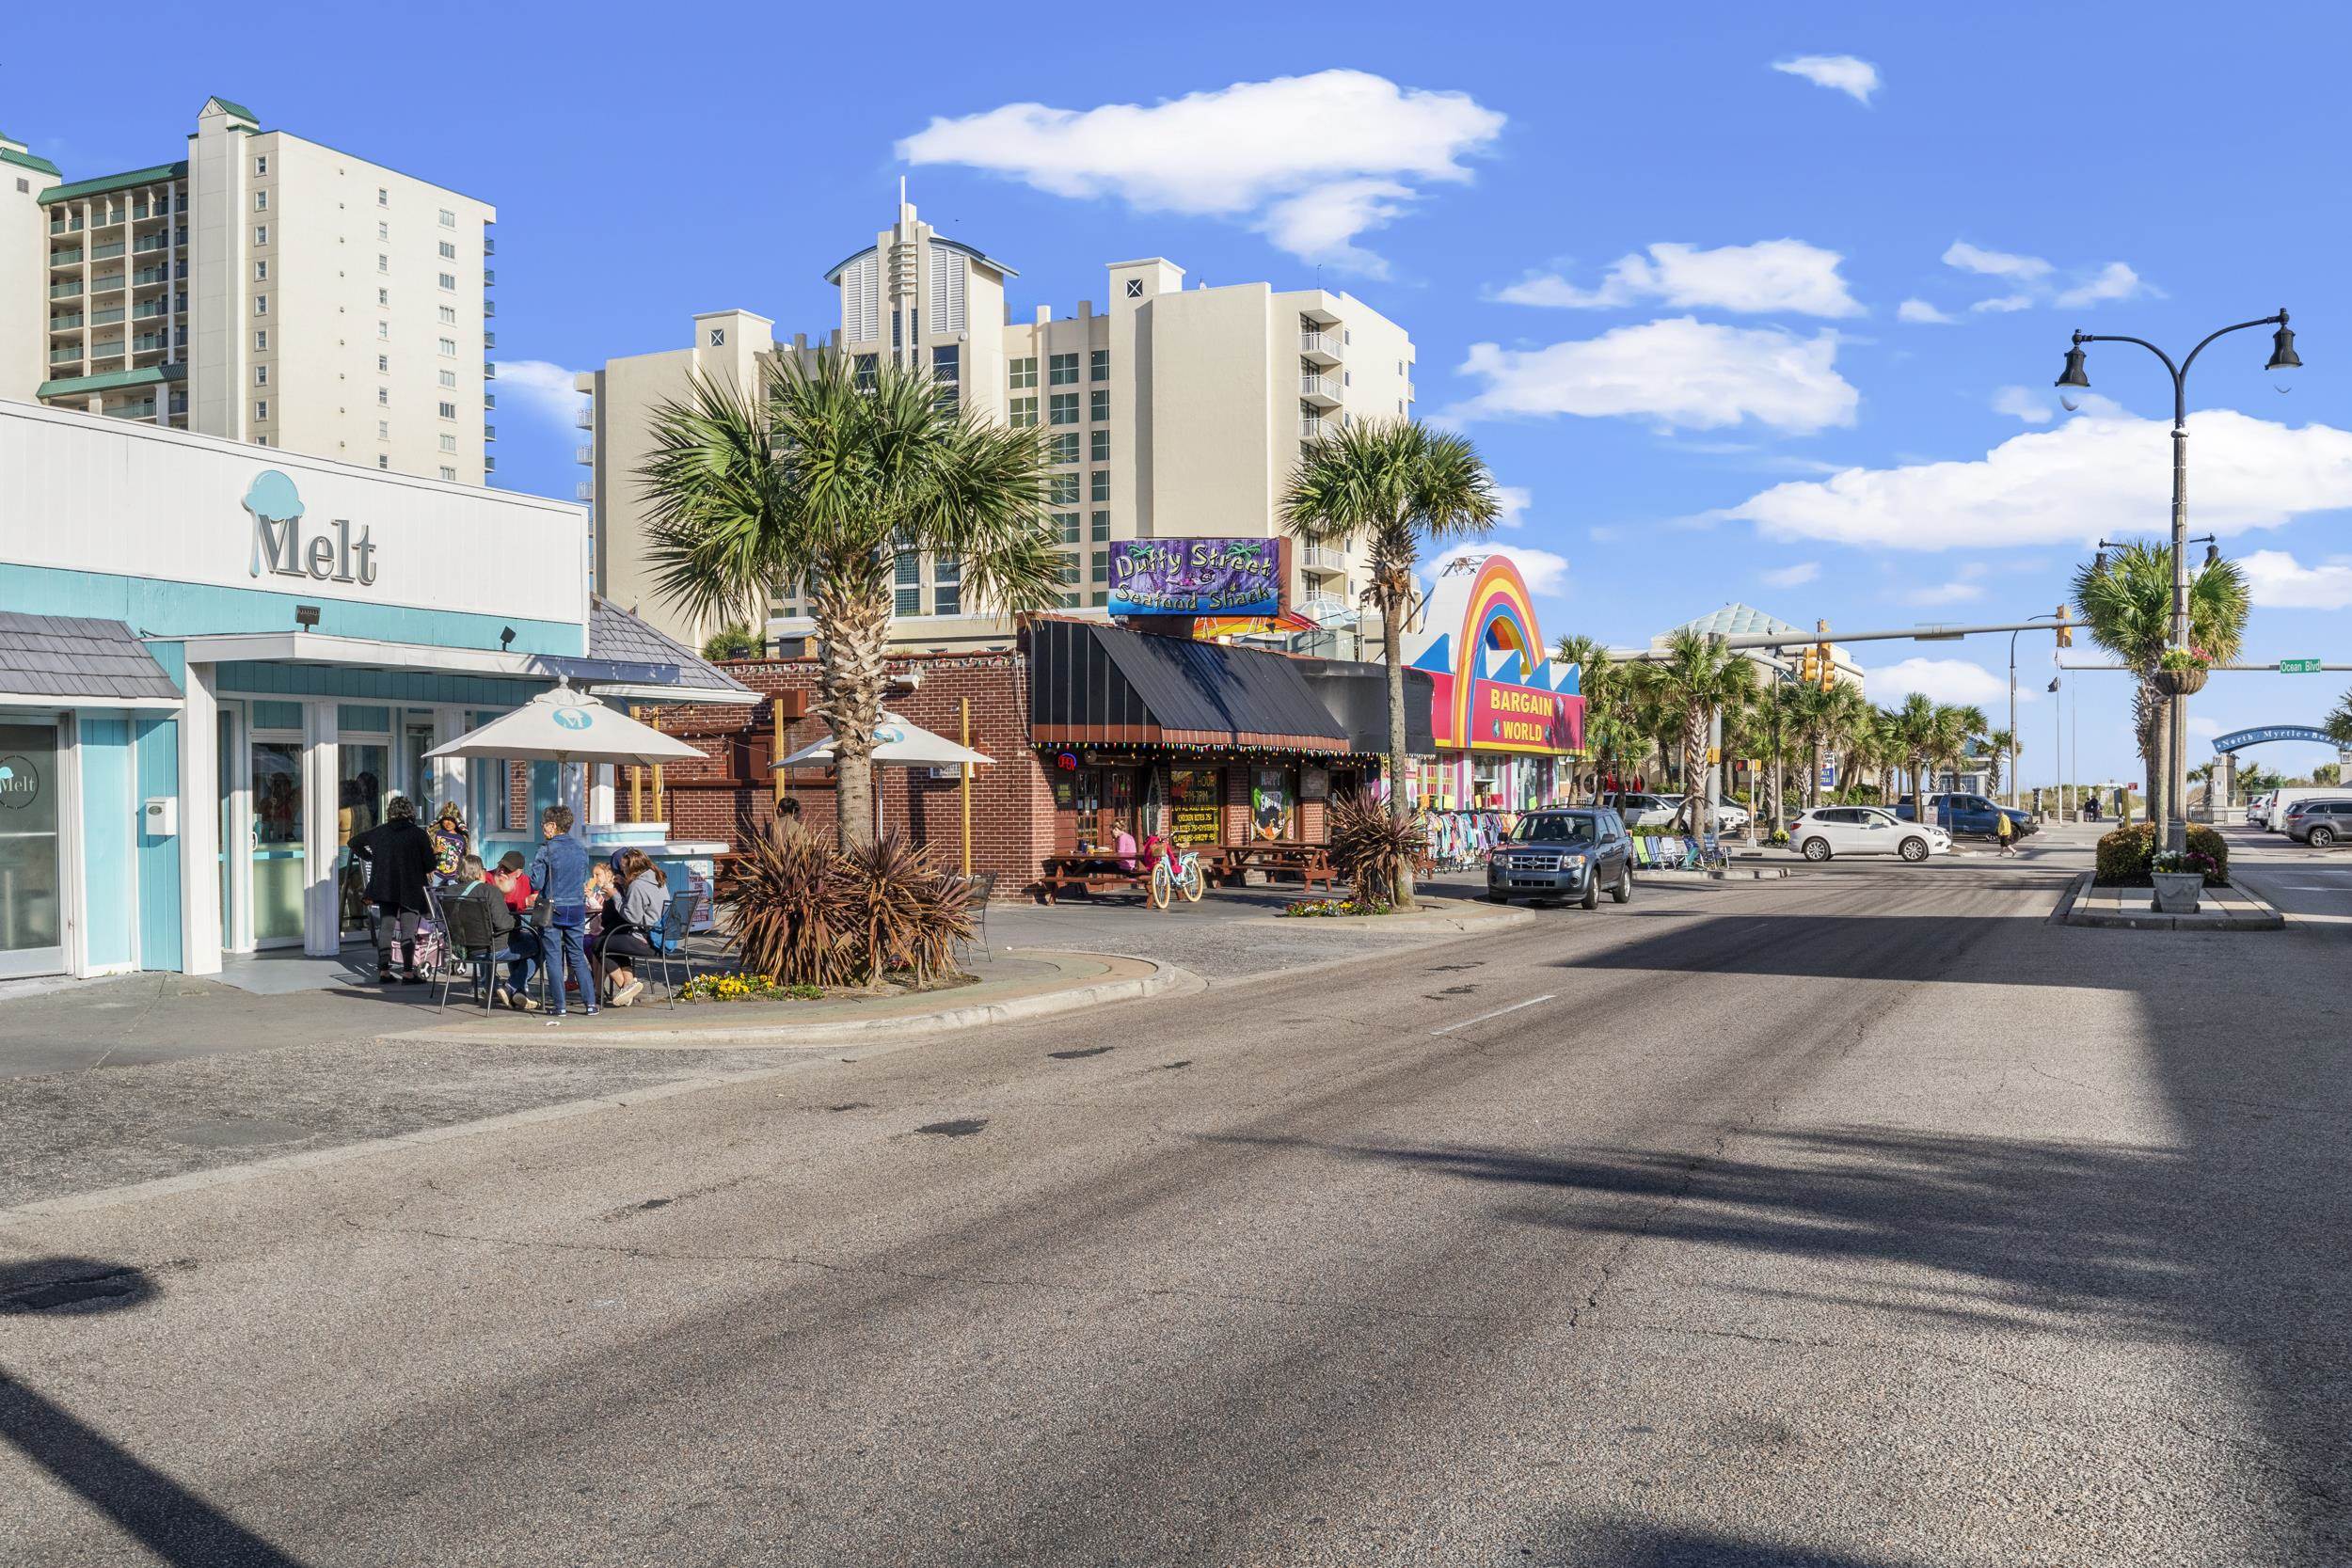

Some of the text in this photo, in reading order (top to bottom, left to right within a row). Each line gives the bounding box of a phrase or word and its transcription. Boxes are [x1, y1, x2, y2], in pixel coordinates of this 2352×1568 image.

[257, 513, 377, 586] Melt
[1115, 543, 1273, 580] Duffy Street
[1115, 581, 1270, 611] Seafood Shack
[2280, 660, 2320, 672] Ocean Blvd
[1490, 688, 1552, 717] BARGAIN
[1502, 721, 1542, 742] WORLD
[2222, 734, 2253, 748] North
[2263, 730, 2301, 739] Myrtle
[2, 776, 35, 792] Melt
